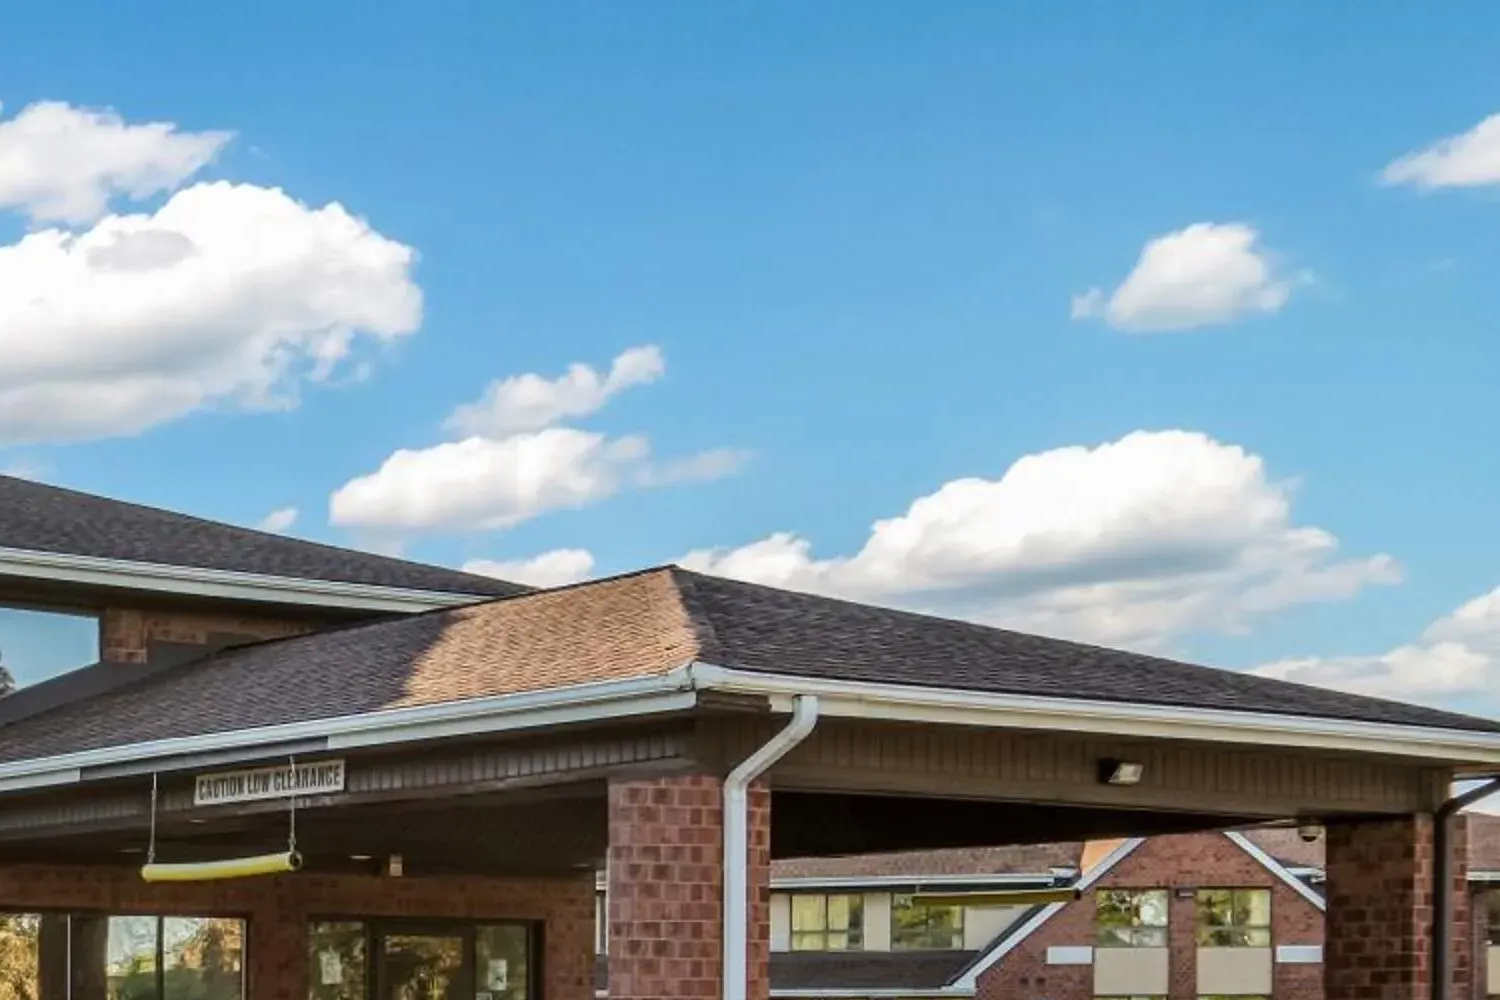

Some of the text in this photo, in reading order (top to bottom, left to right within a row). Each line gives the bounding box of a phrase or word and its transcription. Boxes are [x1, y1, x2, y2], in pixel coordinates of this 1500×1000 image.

[199, 764, 341, 800] CAUTION LOW CLEARANCE
